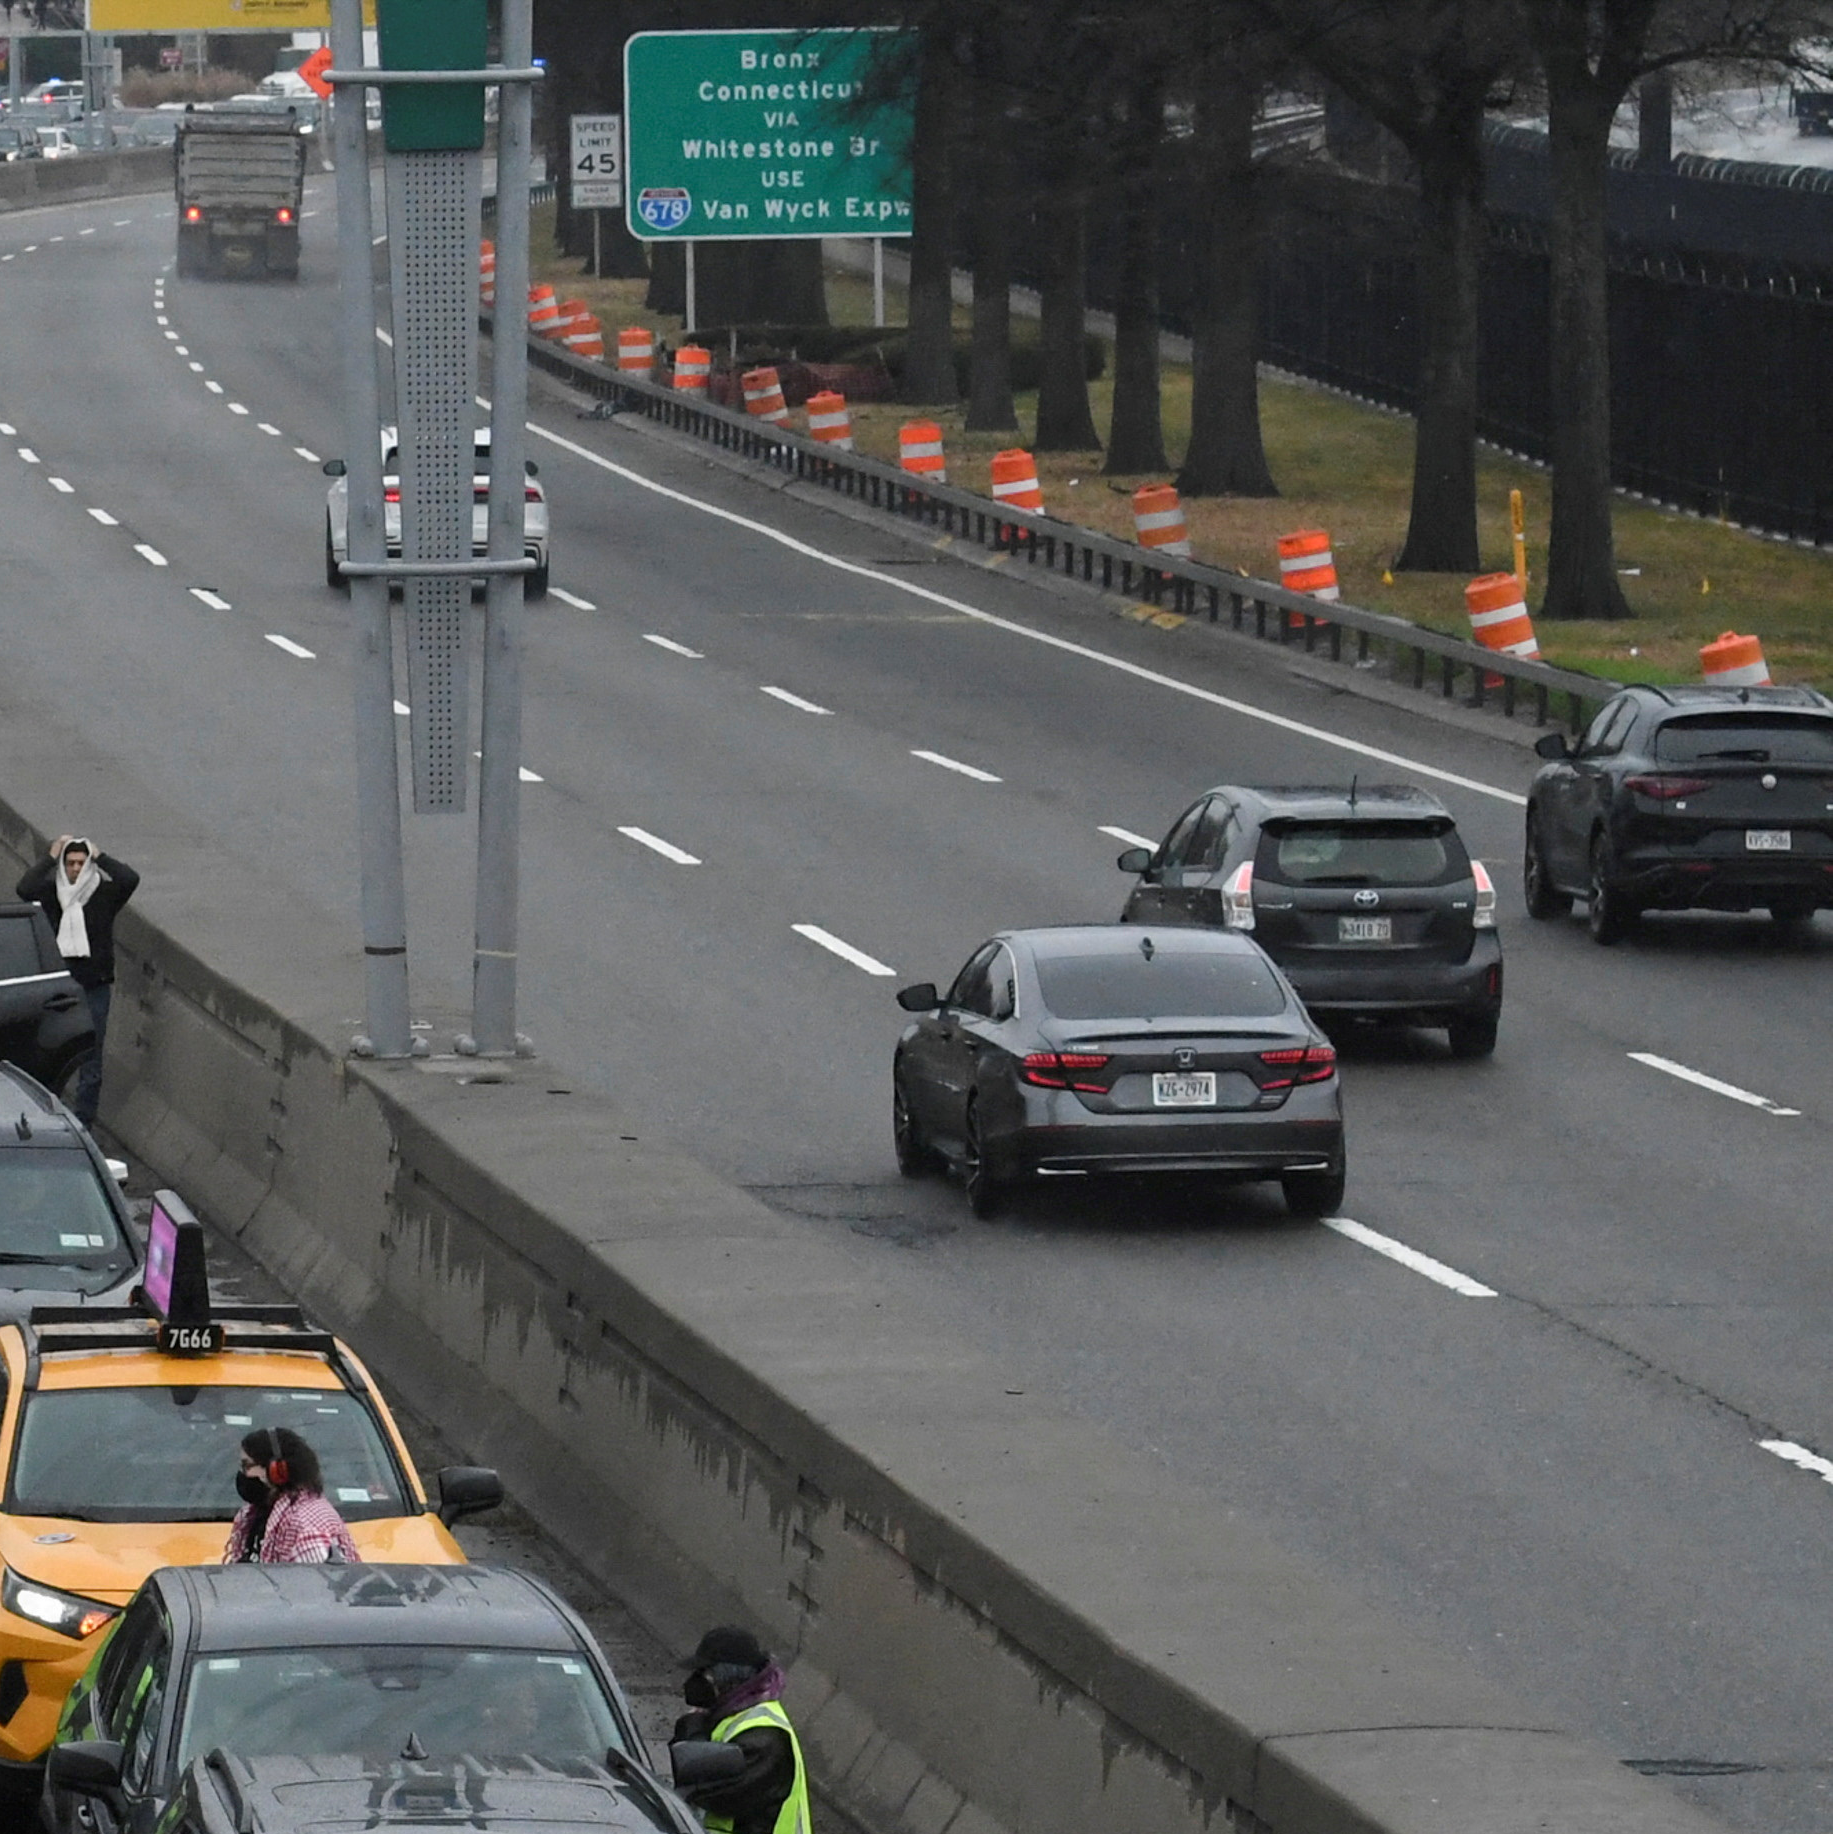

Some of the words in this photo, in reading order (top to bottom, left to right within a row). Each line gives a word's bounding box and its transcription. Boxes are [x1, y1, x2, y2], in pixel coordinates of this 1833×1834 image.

[741, 50, 820, 69] Bronx
[576, 122, 616, 132] SPEED
[764, 112, 799, 128] VIA
[579, 138, 611, 148] LIMIT
[683, 139, 834, 159] Whitestone
[577, 153, 615, 174] 45
[762, 171, 804, 188] USE
[645, 201, 684, 220] 678
[703, 200, 749, 220] Van
[765, 199, 831, 223] Wyck
[846, 199, 912, 223] Expw
[169, 1328, 212, 1348] 7G66
